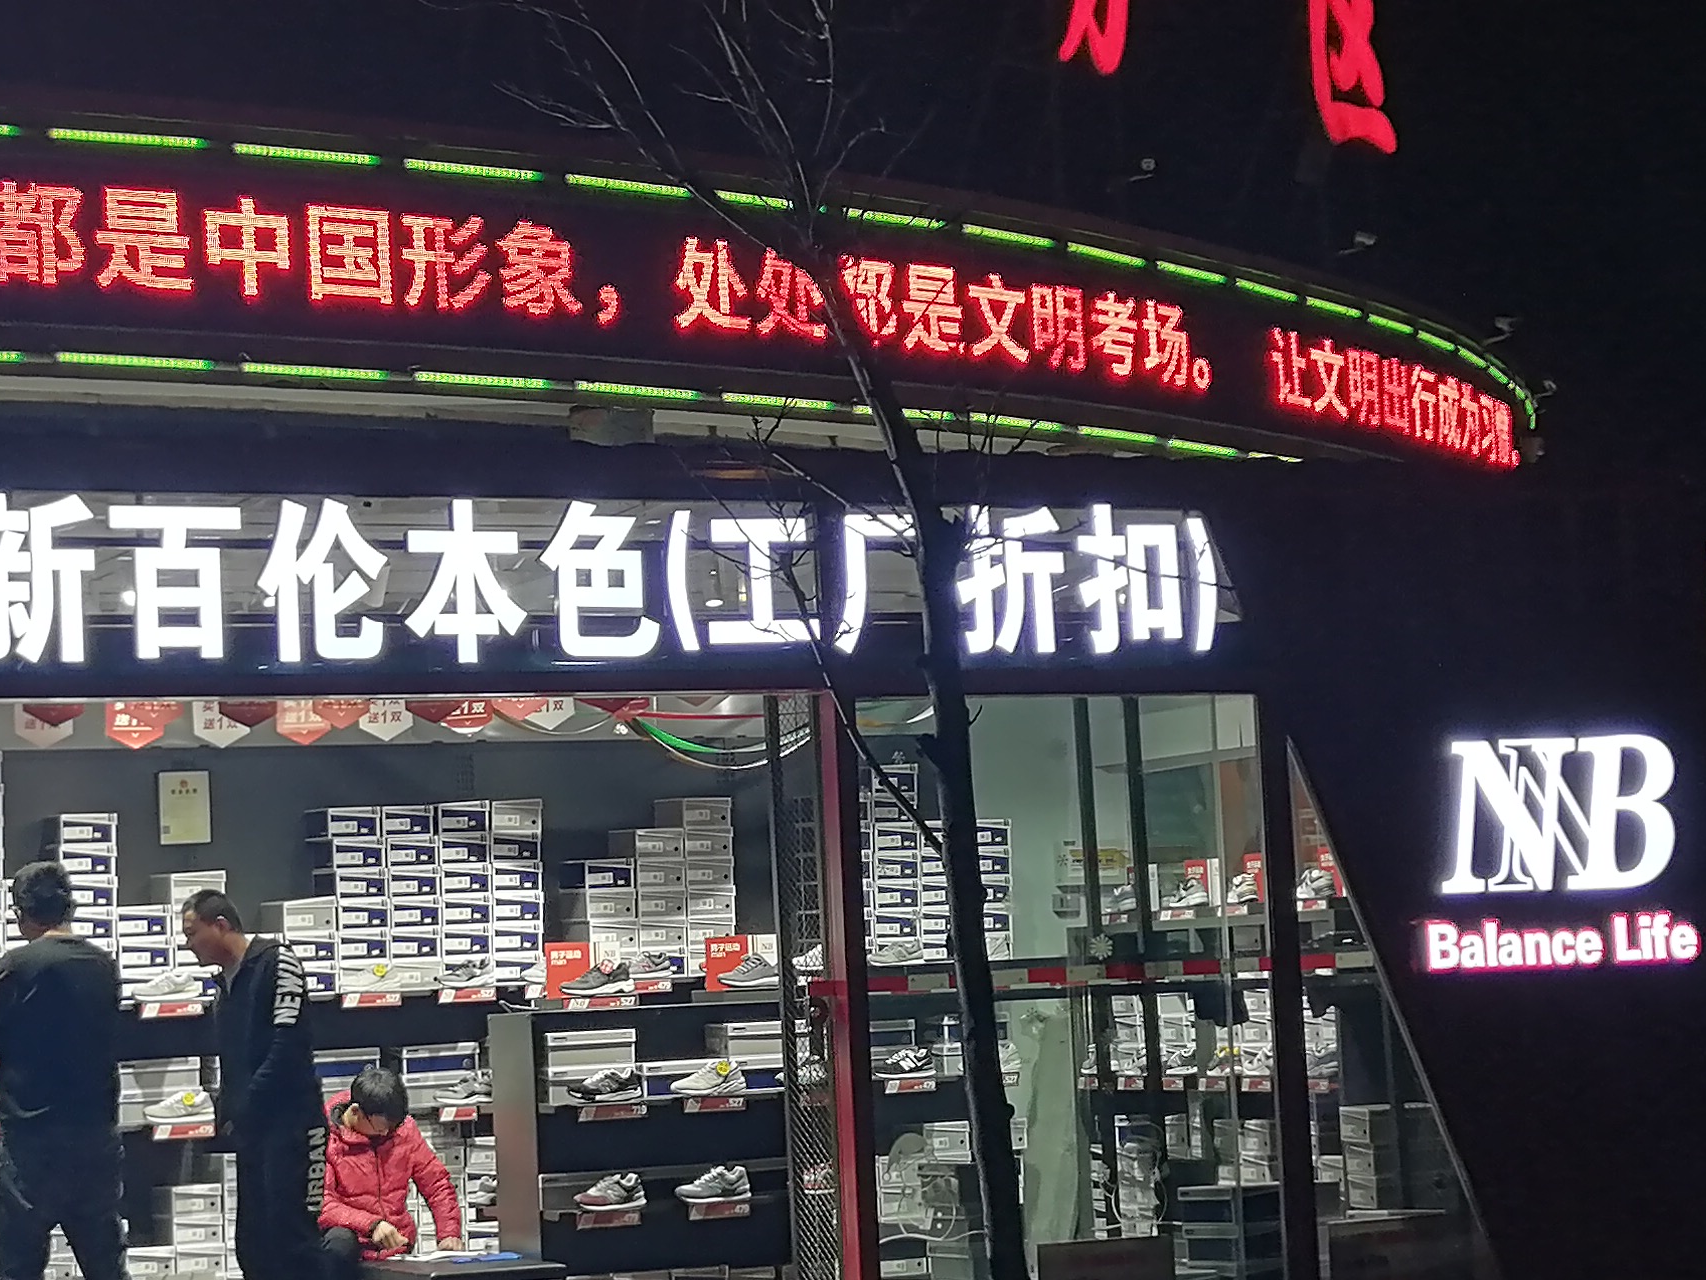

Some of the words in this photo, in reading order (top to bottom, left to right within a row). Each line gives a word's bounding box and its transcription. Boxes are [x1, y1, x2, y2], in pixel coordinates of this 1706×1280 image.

[1427, 918, 1605, 971] Balance
[1611, 911, 1699, 964] Life
[305, 1126, 327, 1213] URBAN
